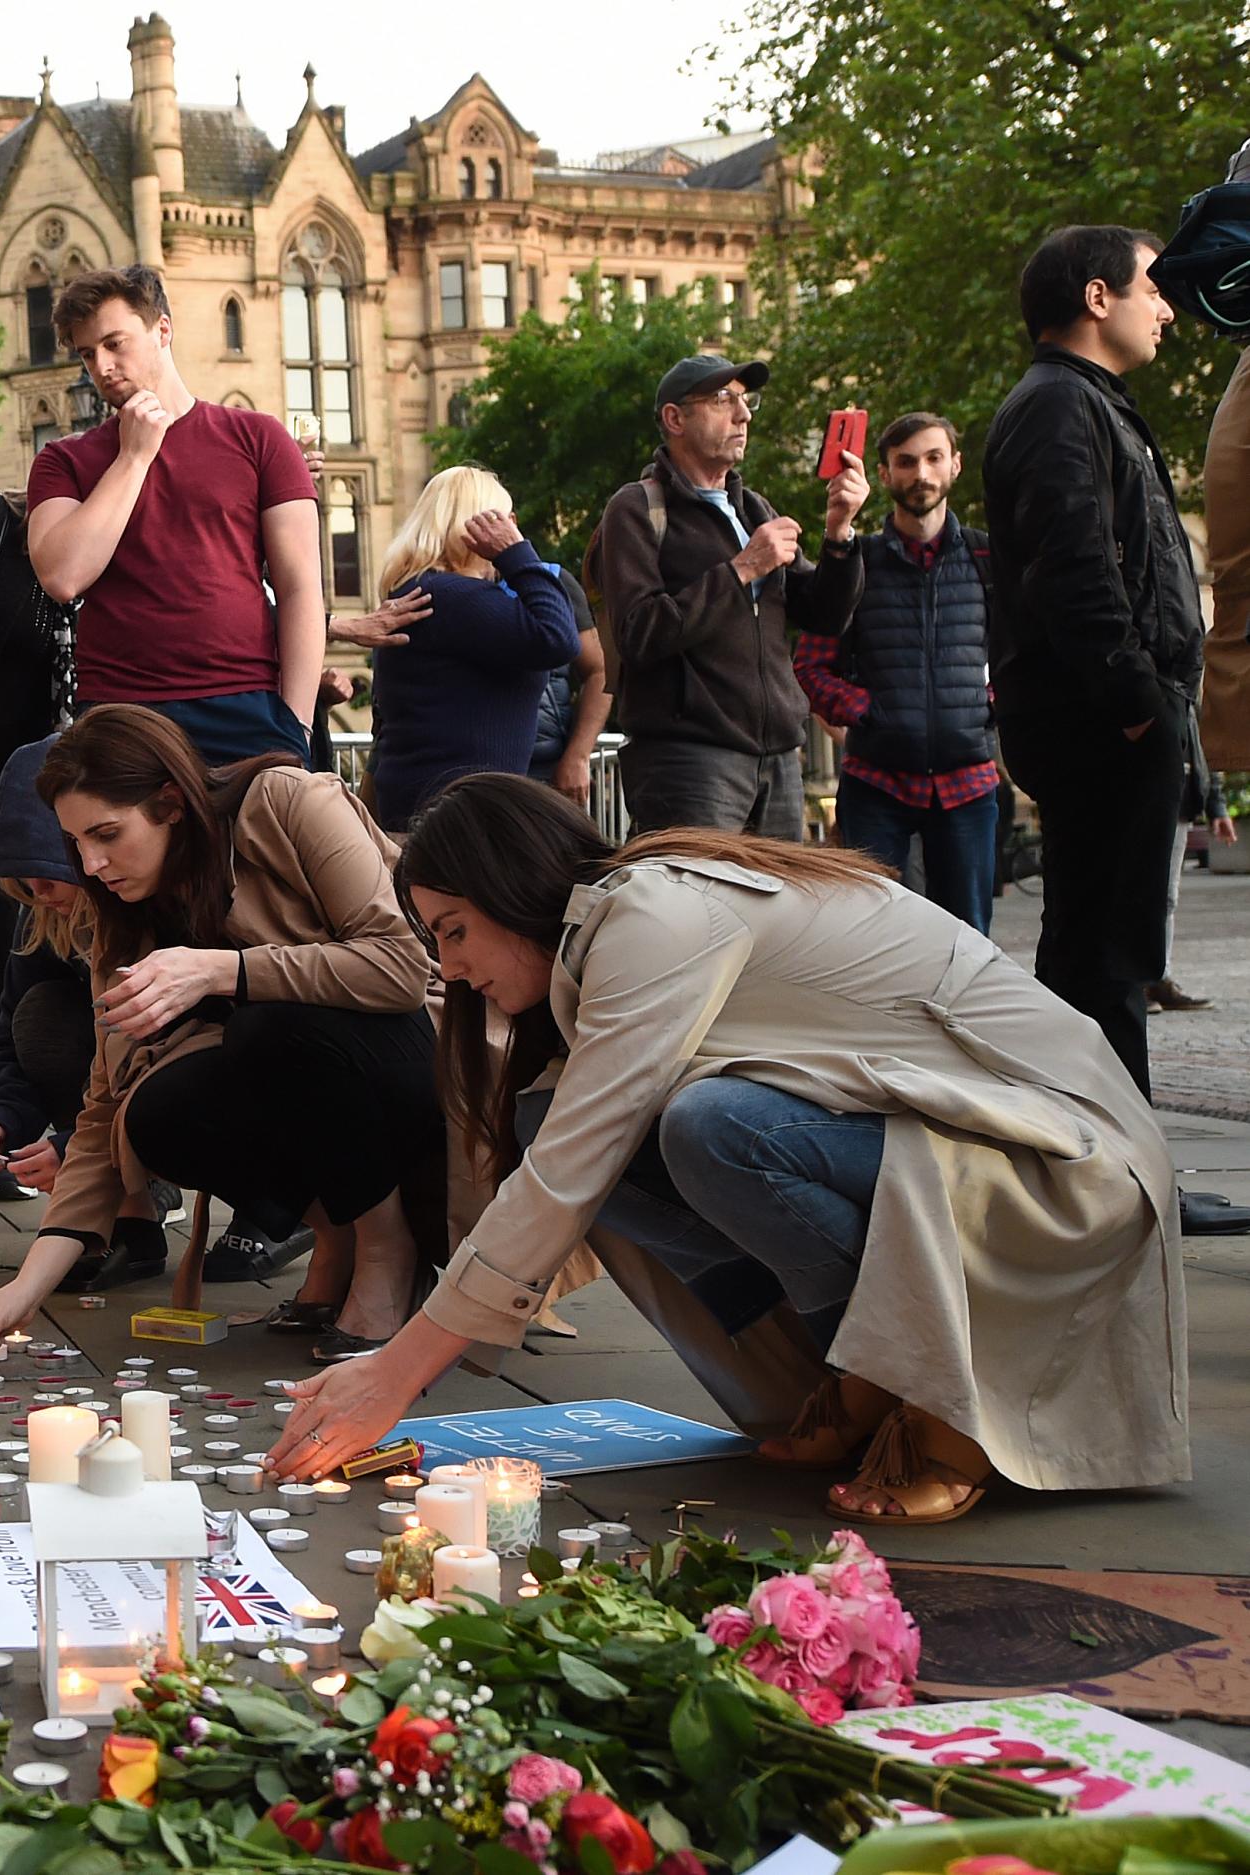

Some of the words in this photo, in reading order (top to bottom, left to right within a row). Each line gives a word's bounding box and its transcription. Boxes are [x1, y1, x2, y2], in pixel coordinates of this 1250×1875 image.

[523, 1426, 601, 1443] WE
[564, 1409, 682, 1443] STAND
[438, 1420, 583, 1463] UNITED
[1, 1555, 33, 1576] Love
